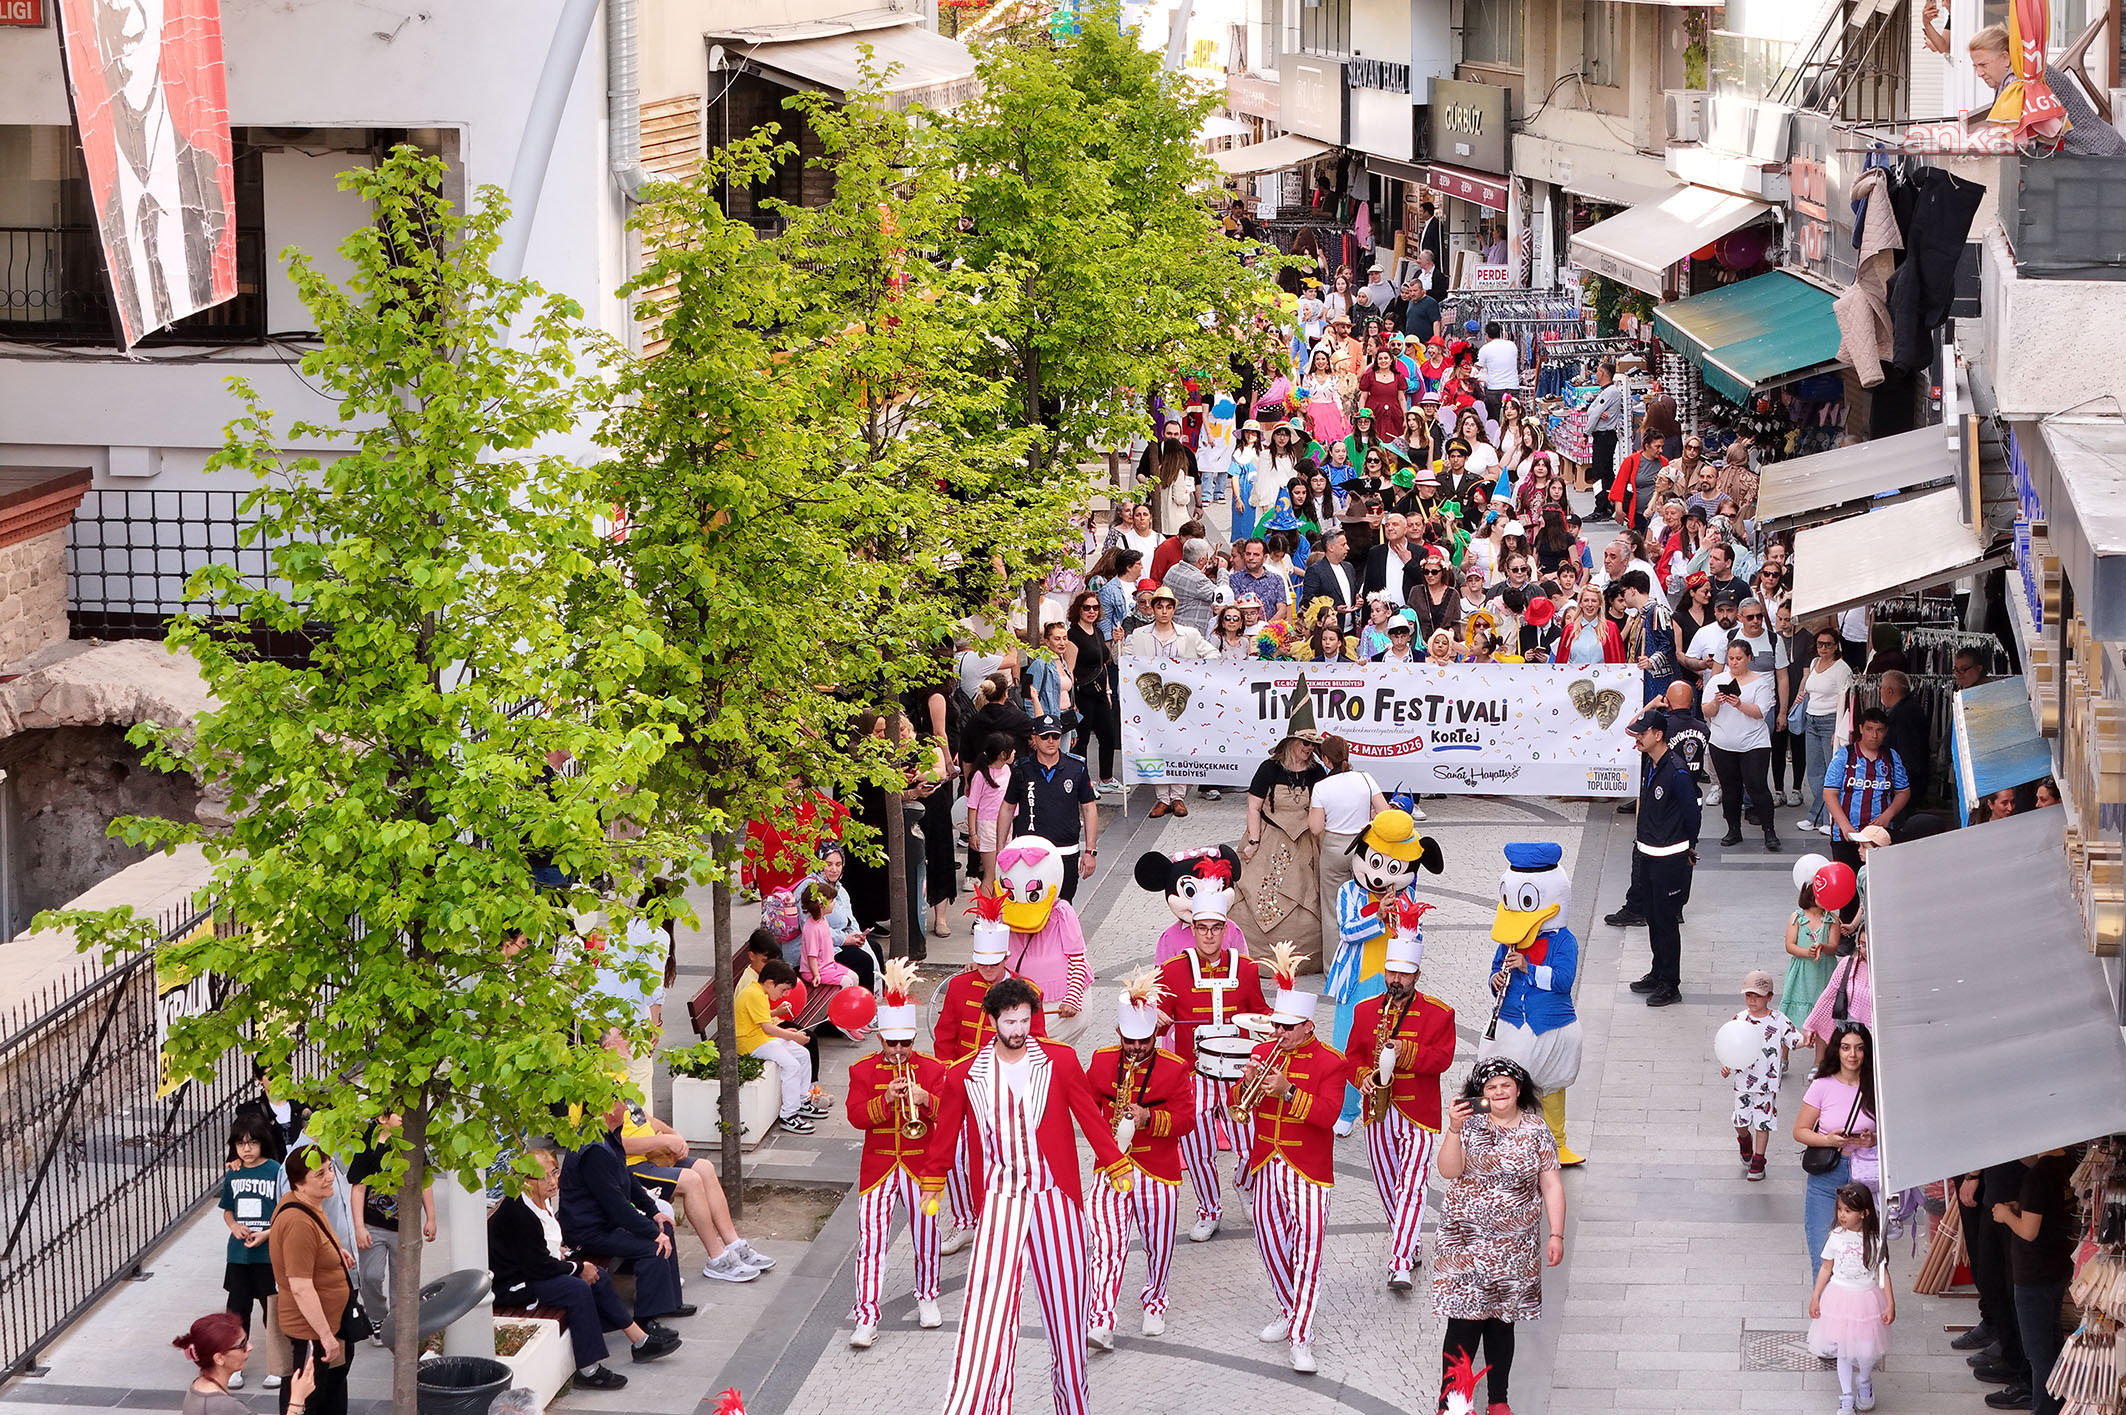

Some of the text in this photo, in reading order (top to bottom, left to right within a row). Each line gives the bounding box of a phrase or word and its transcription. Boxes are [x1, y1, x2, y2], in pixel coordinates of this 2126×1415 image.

[1445, 102, 1482, 136] GÜRBÜZ
[1477, 269, 1509, 281] PERDE
[1251, 681, 1365, 722] TİYTRO
[1362, 745, 1394, 756] MAYIS
[1396, 739, 1422, 754] 2026
[1165, 759, 1239, 772] T.C. BÜYÜKÇEKMECE
[1166, 768, 1207, 778] BELEDİYESİ
[1846, 776, 1892, 790] papara
[1027, 781, 1036, 832] ZABITA
